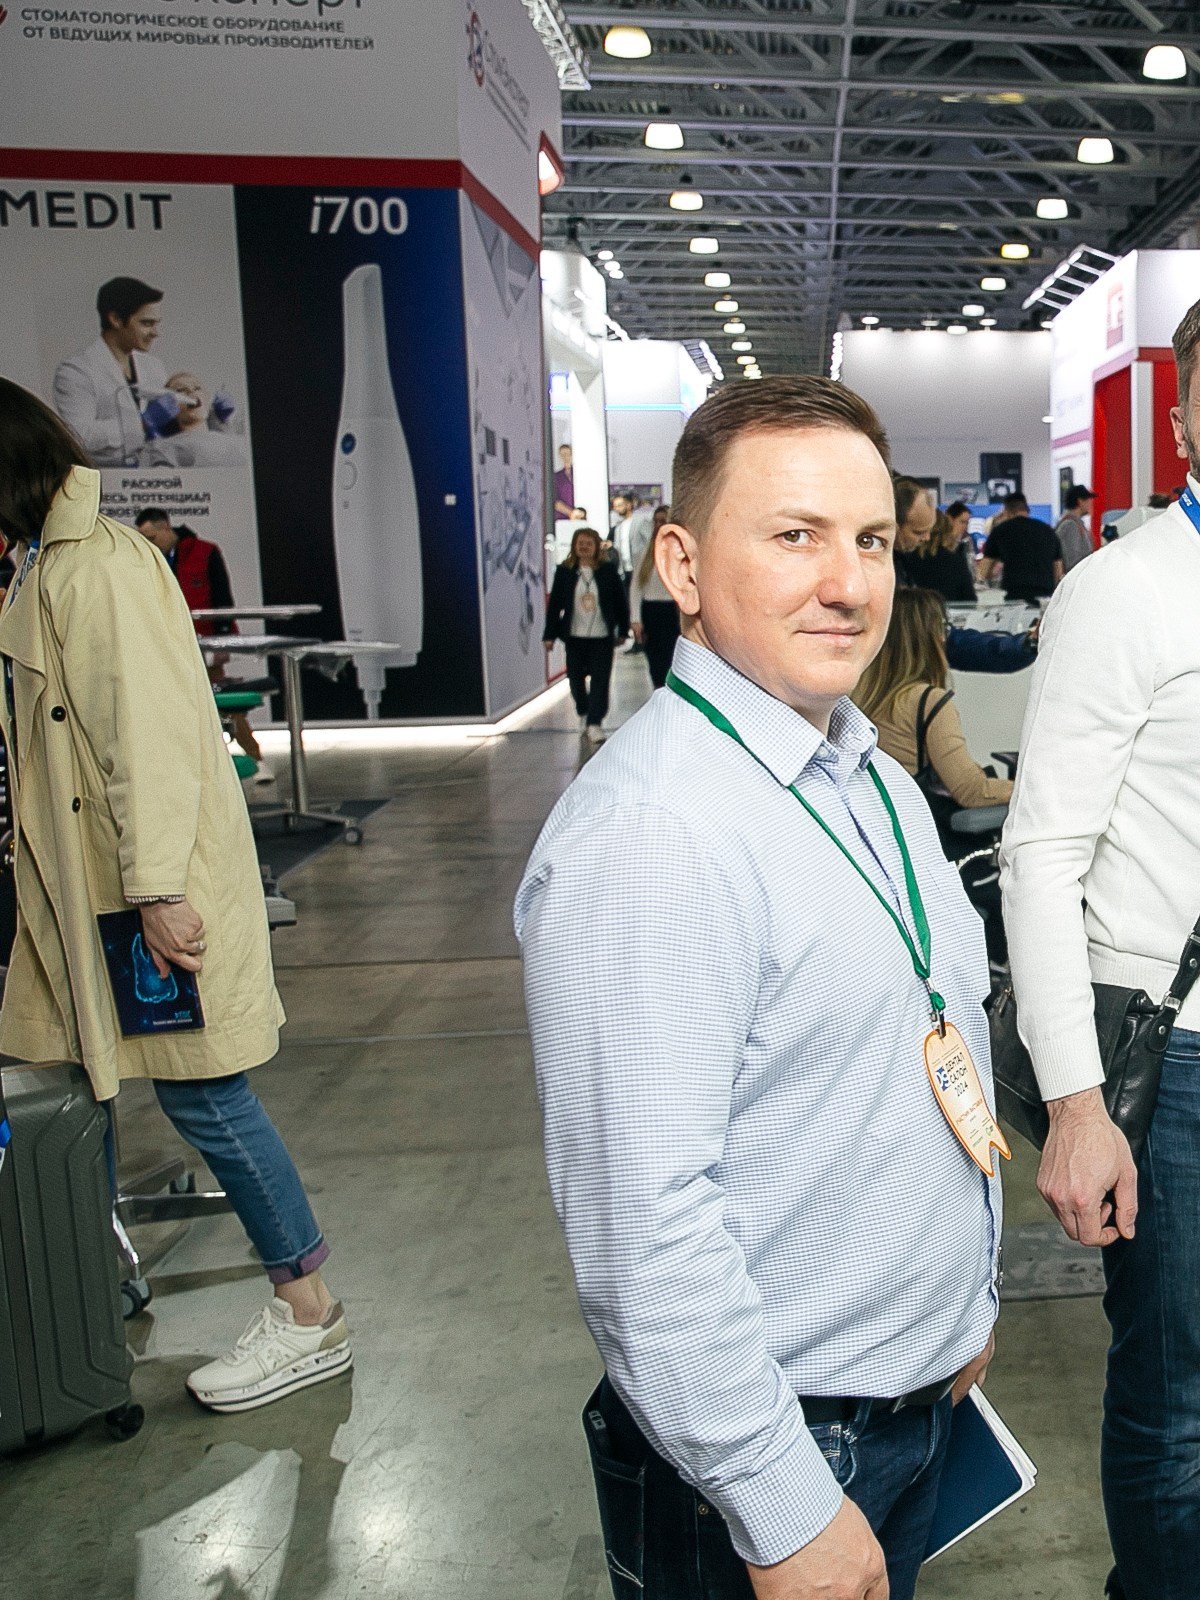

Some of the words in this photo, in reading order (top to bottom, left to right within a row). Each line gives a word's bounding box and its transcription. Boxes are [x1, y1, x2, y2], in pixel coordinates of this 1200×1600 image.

[21, 8, 208, 29] СТОМАТОЛОГИЧЕСКОЕ
[212, 15, 345, 33] ОБОРУДОВАНИЕ
[23, 26, 45, 39] ОТ
[50, 27, 131, 42] ВЕДУЩИХ
[136, 31, 222, 46] МИРОВЫХ
[225, 34, 374, 50] ПРОИЗВОДИТЕЛЕЙ
[0, 190, 173, 230] MEDIT
[309, 196, 408, 235] i700
[122, 477, 182, 489] РАСКРОЙ
[101, 492, 129, 503] ЕСЬ
[131, 491, 211, 504] ПОТЕНЦИАЛ
[945, 1051, 965, 1075] ДЕНТАЛ
[949, 1065, 968, 1085] САЛОН
[954, 1081, 969, 1098] 2024
